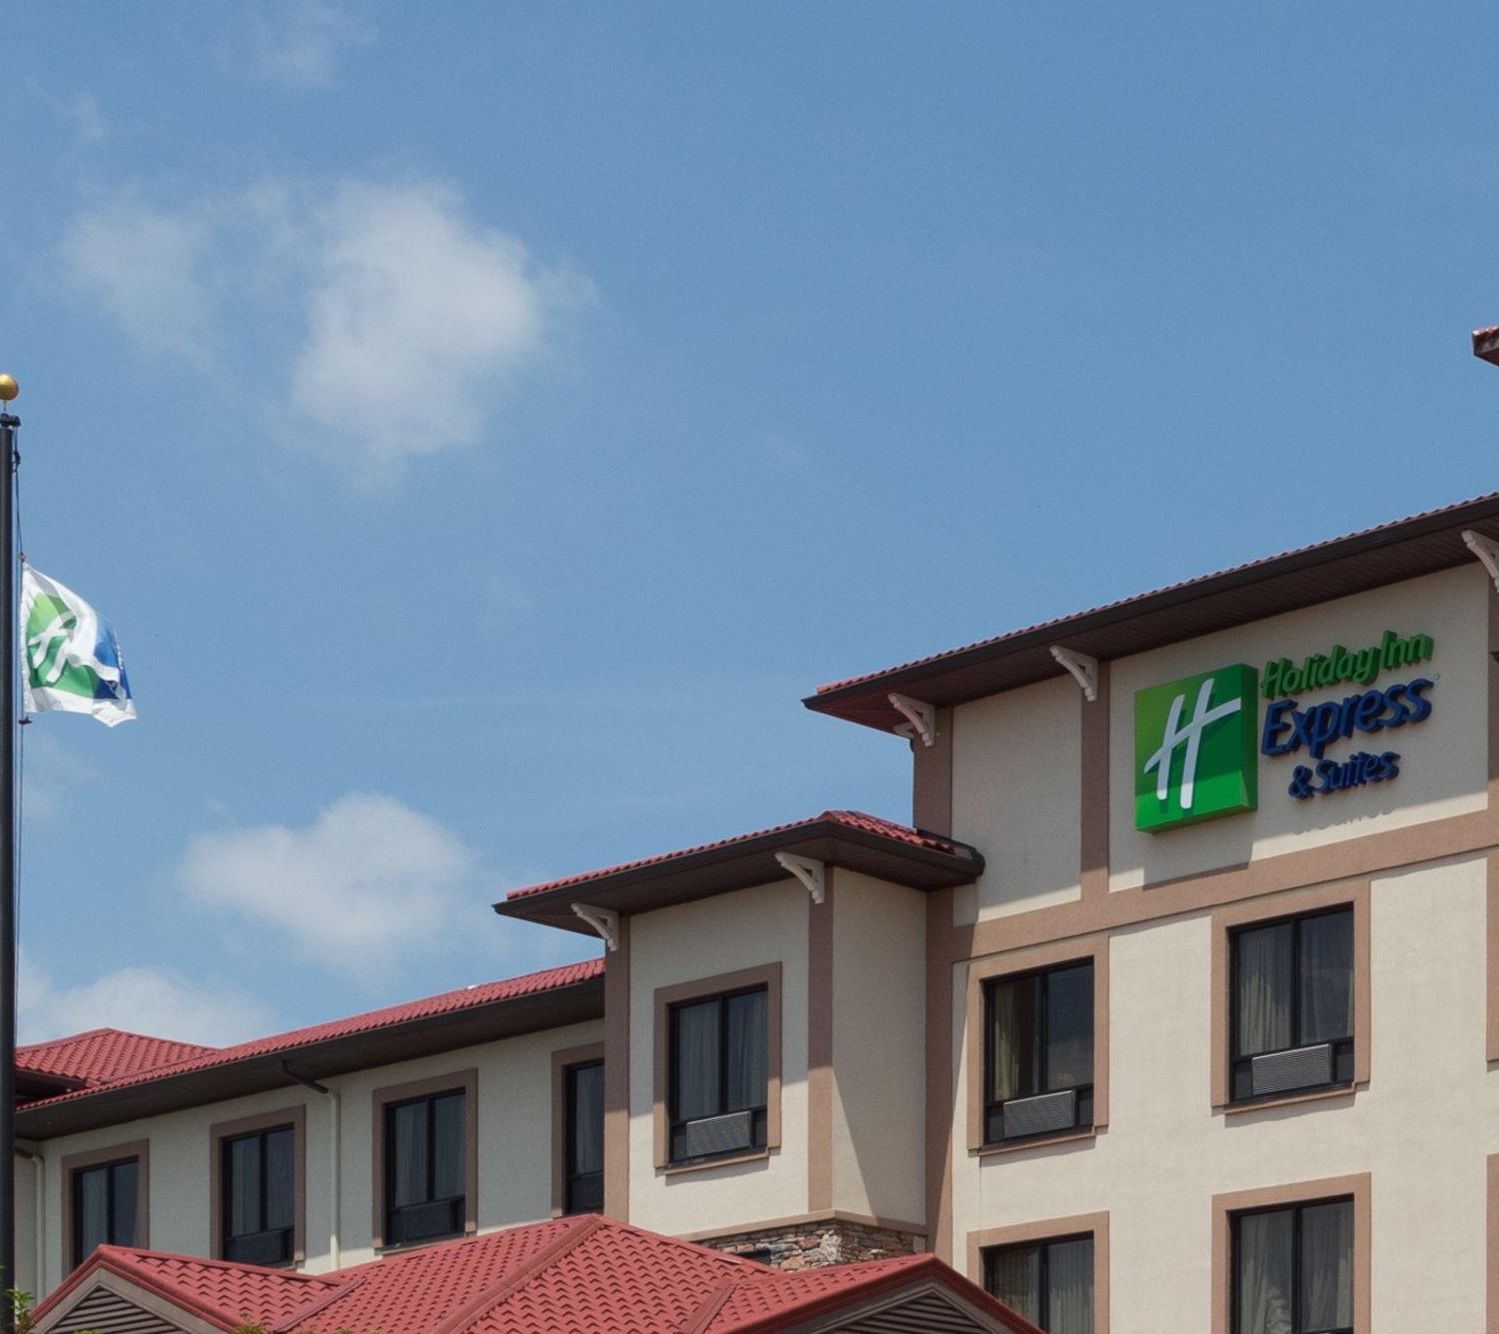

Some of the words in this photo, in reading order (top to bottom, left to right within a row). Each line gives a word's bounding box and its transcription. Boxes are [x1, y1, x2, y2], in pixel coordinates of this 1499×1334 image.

[1261, 644, 1381, 700] Holiday
[1378, 630, 1434, 669] Inn
[1261, 678, 1434, 759] Express
[1288, 765, 1314, 799] &
[1315, 751, 1400, 794] Suites
